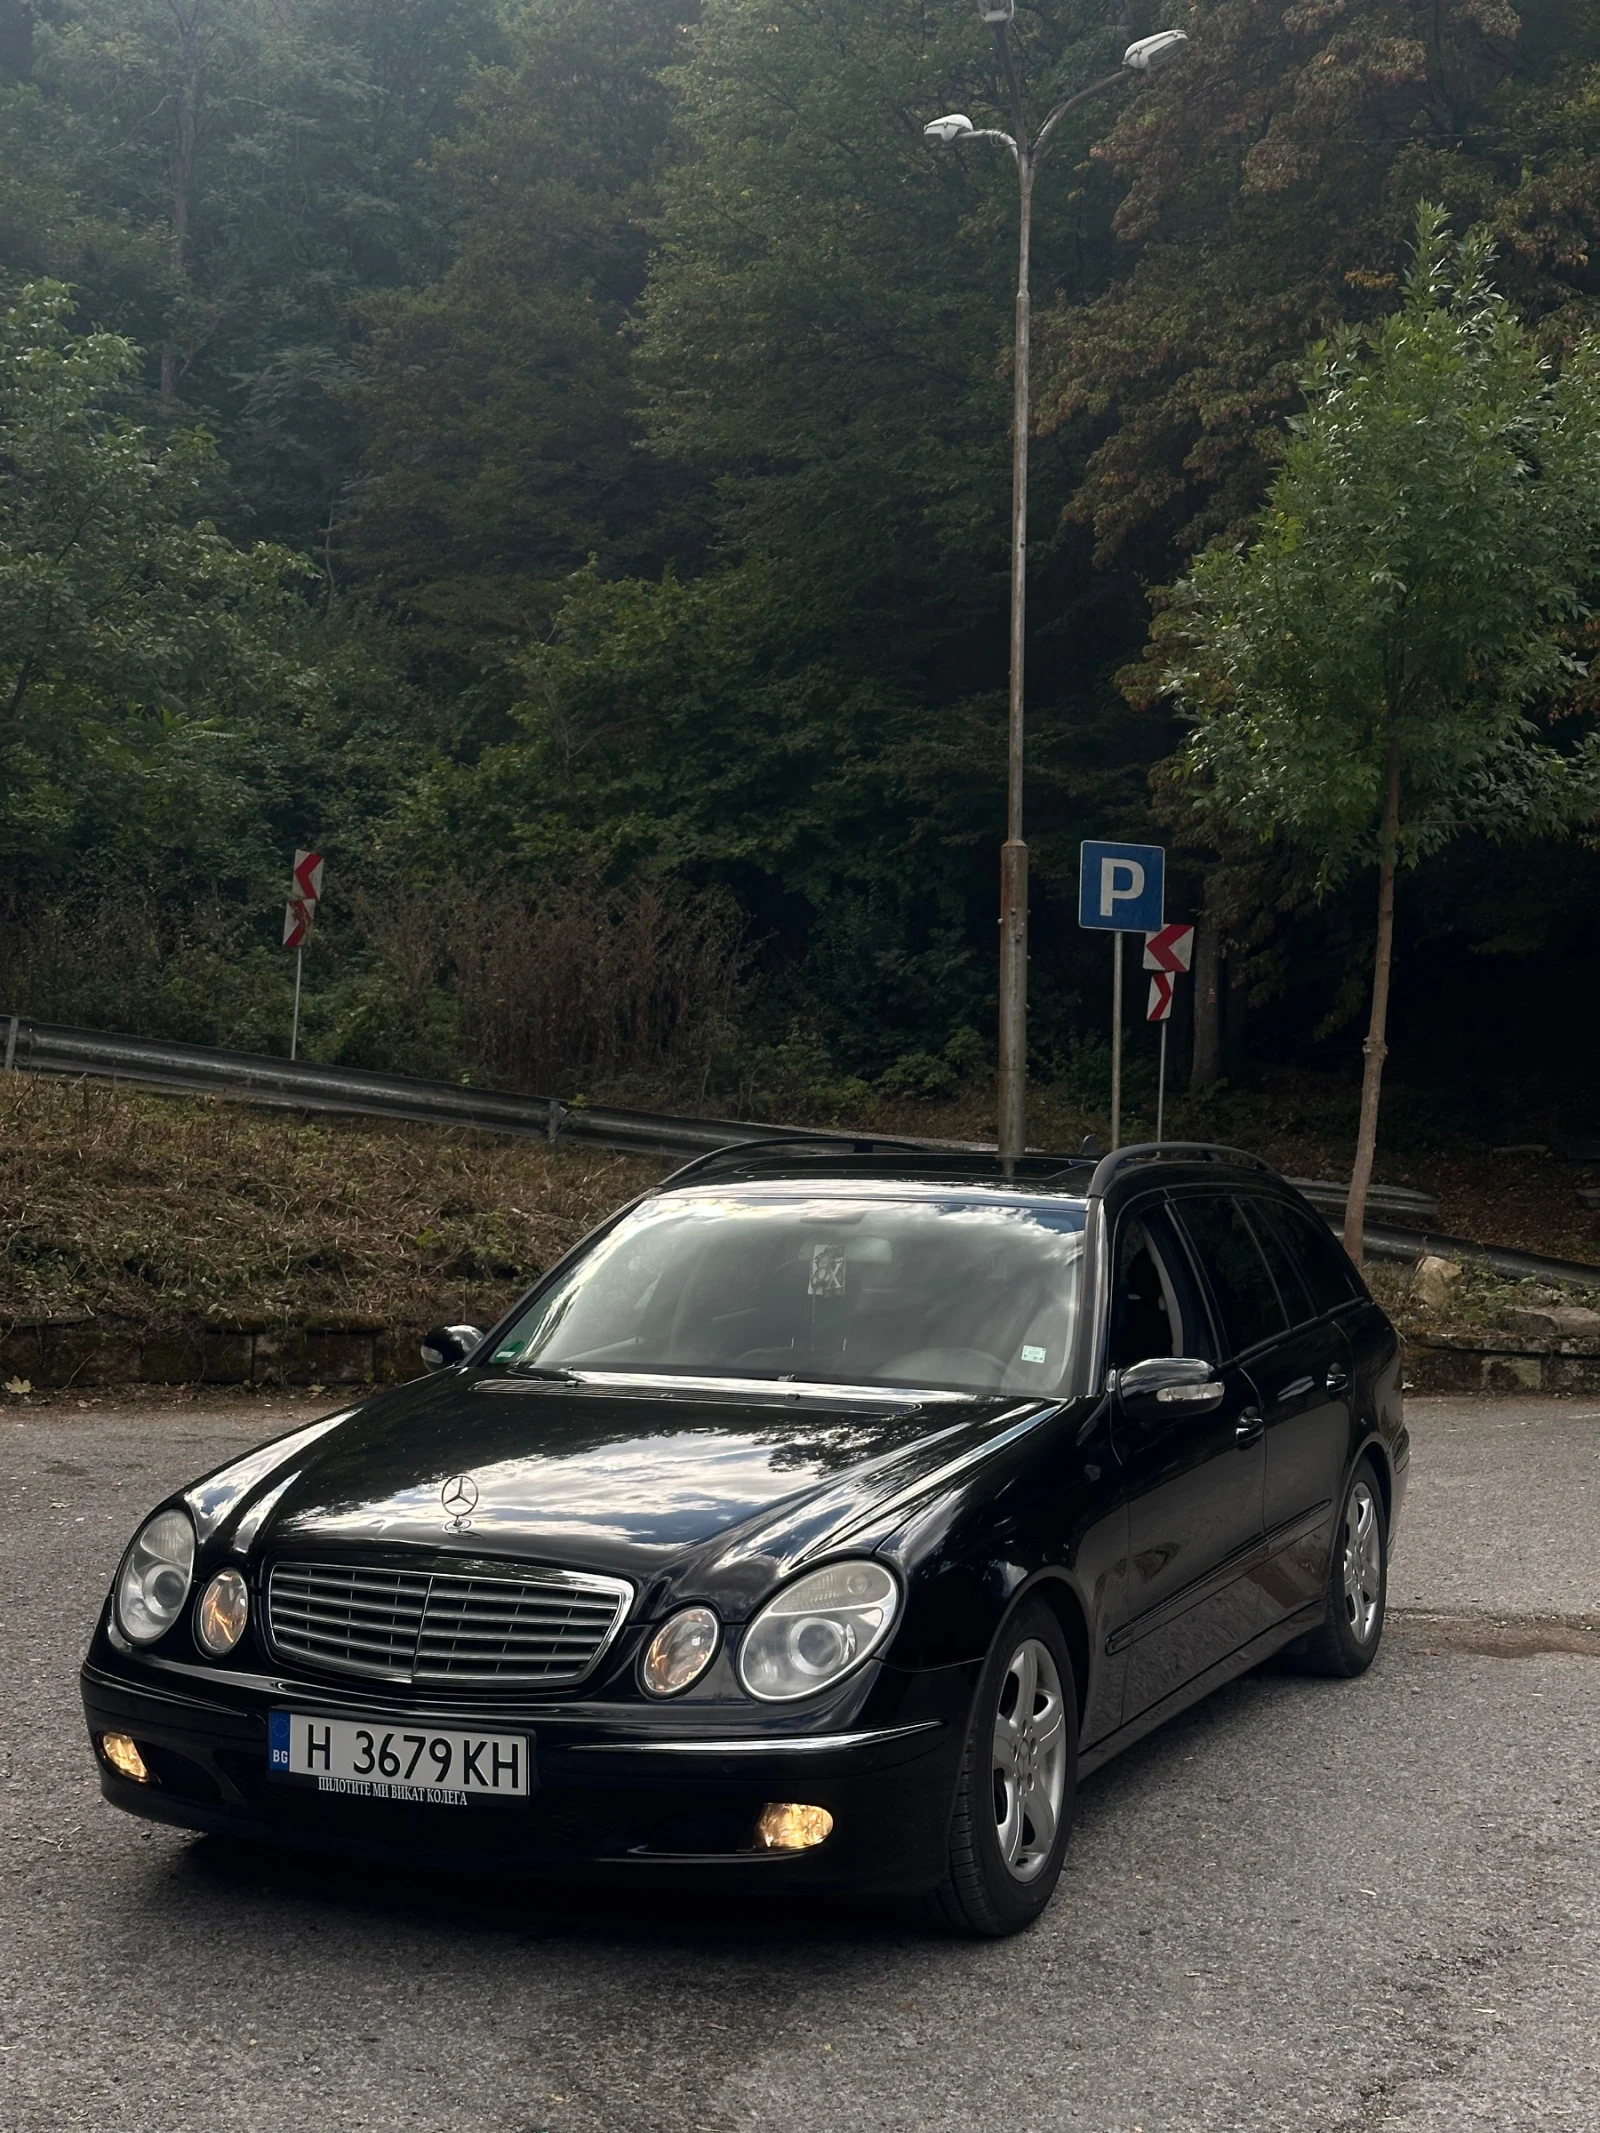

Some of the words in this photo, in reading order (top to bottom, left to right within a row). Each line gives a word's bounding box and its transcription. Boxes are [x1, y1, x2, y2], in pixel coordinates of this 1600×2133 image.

[1100, 857, 1145, 916] P
[272, 1749, 289, 1764] BG
[307, 1723, 331, 1770] H
[353, 1730, 453, 1783] 3679
[318, 1776, 371, 1796] ПИЛОТИТЕ
[372, 1782, 390, 1798] МИ
[391, 1785, 425, 1802] ВИКАТ
[426, 1788, 468, 1806] КОЛЕГА
